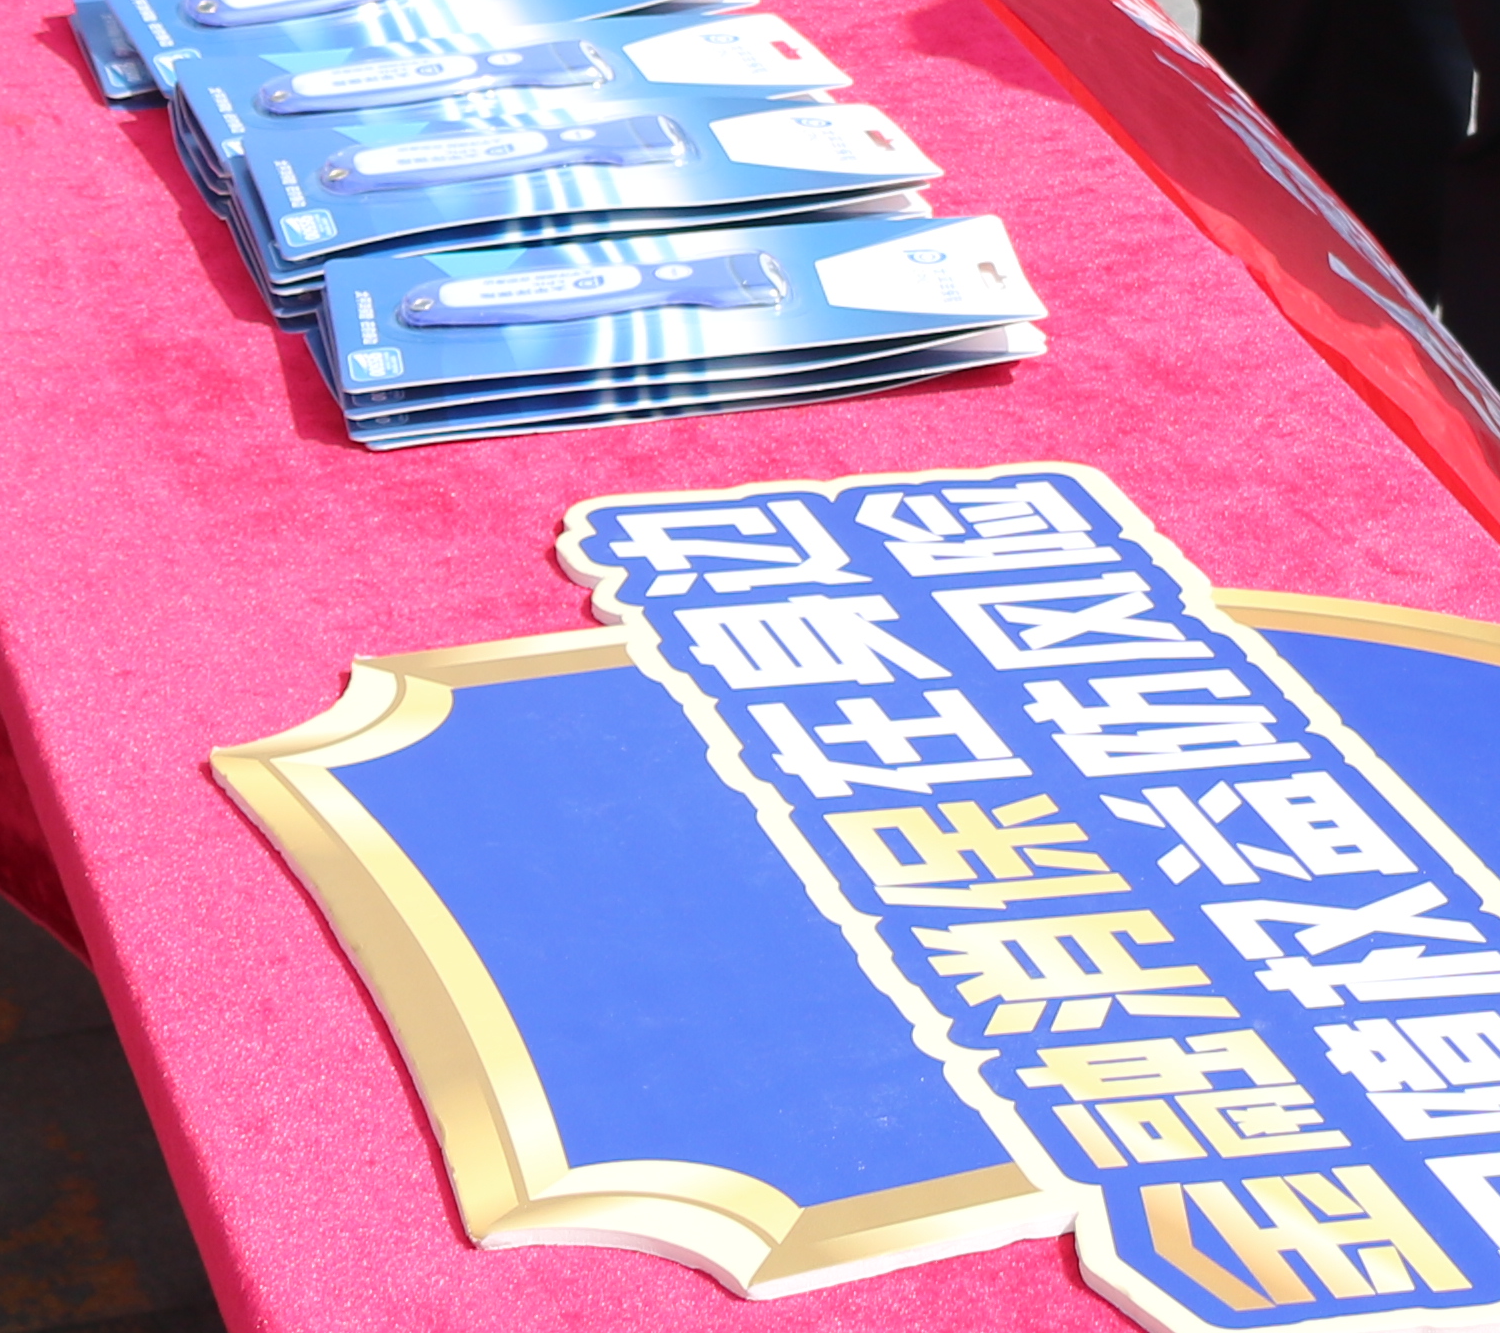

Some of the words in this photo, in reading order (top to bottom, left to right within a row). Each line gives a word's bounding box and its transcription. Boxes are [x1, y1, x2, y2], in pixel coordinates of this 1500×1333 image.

[615, 497, 1472, 1310] 金融消保在身边
